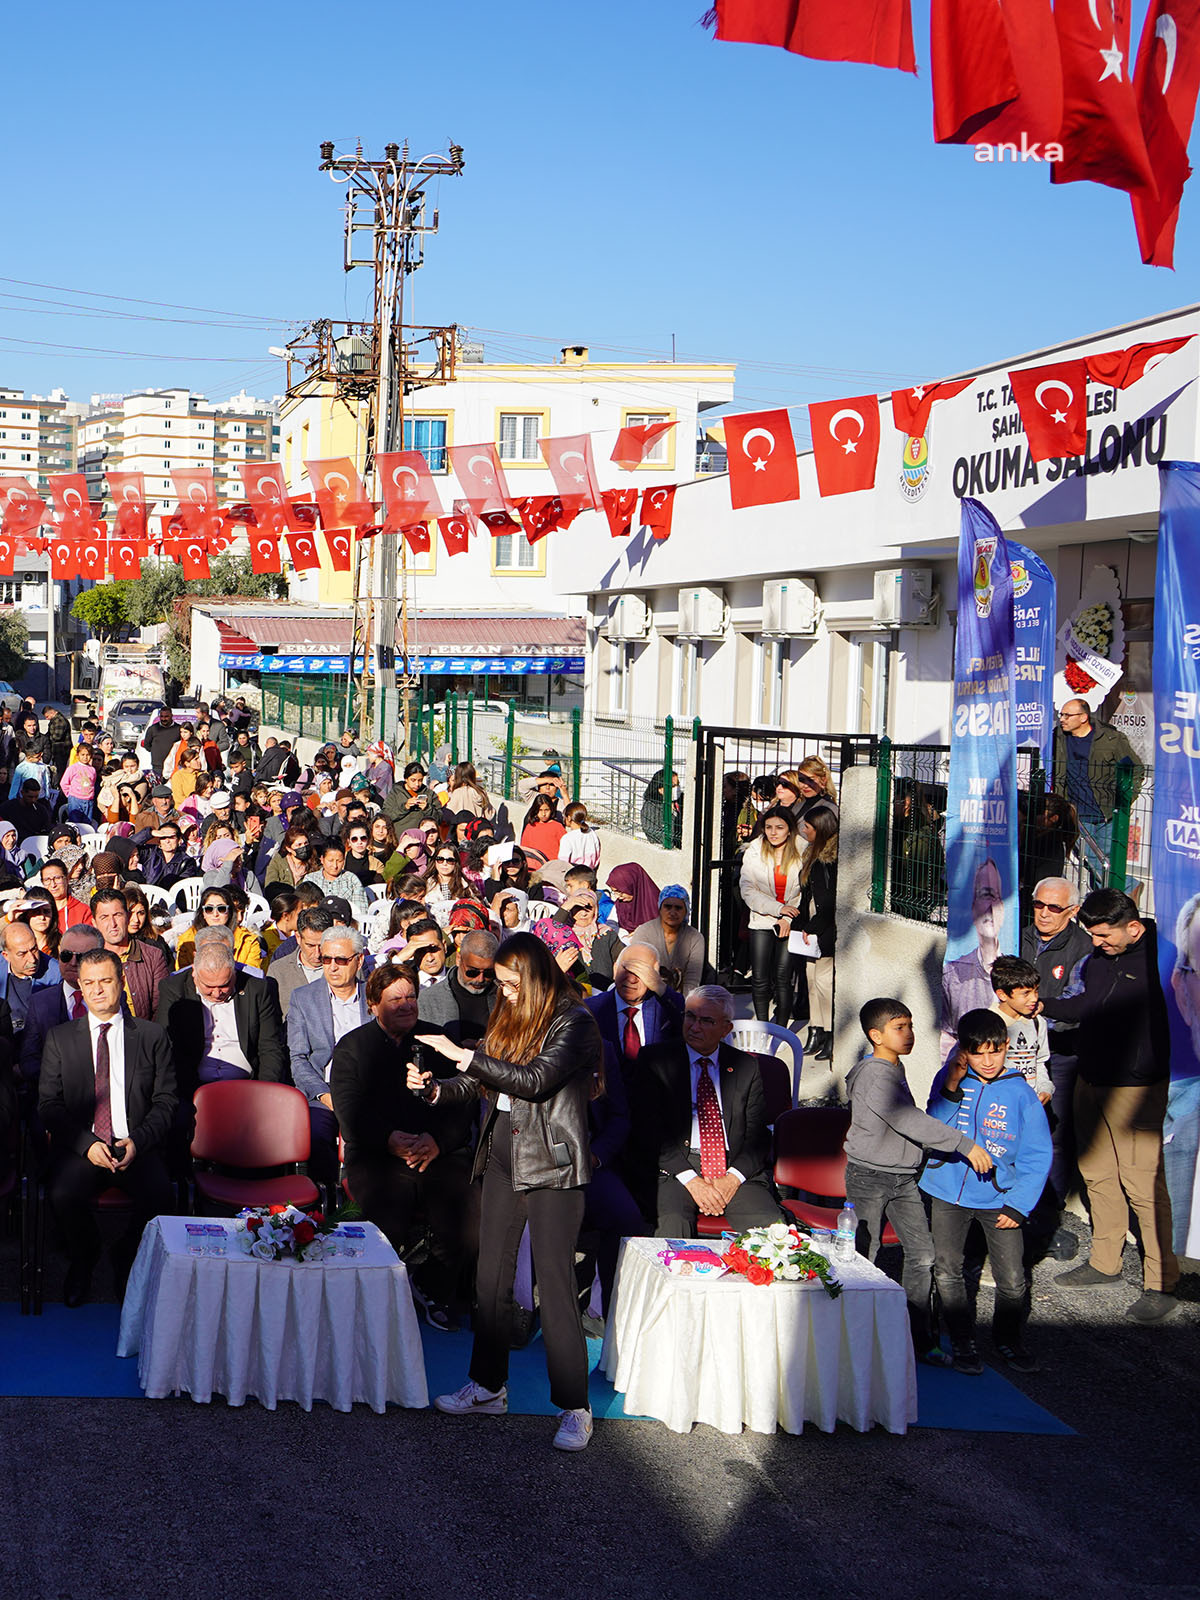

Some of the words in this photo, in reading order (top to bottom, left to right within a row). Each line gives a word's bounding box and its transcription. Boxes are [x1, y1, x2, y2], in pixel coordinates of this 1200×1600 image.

[976, 389, 998, 413] T.C.
[1001, 384, 1018, 406] TA
[953, 445, 1040, 498] OKUMA
[1045, 413, 1168, 482] SALONU
[285, 644, 342, 653] ERZAN
[438, 645, 503, 654] ERZAN
[113, 669, 153, 678] TARSUS
[1112, 714, 1147, 728] TARSUS
[988, 1102, 1008, 1119] 25
[983, 1118, 1008, 1131] HOPE
